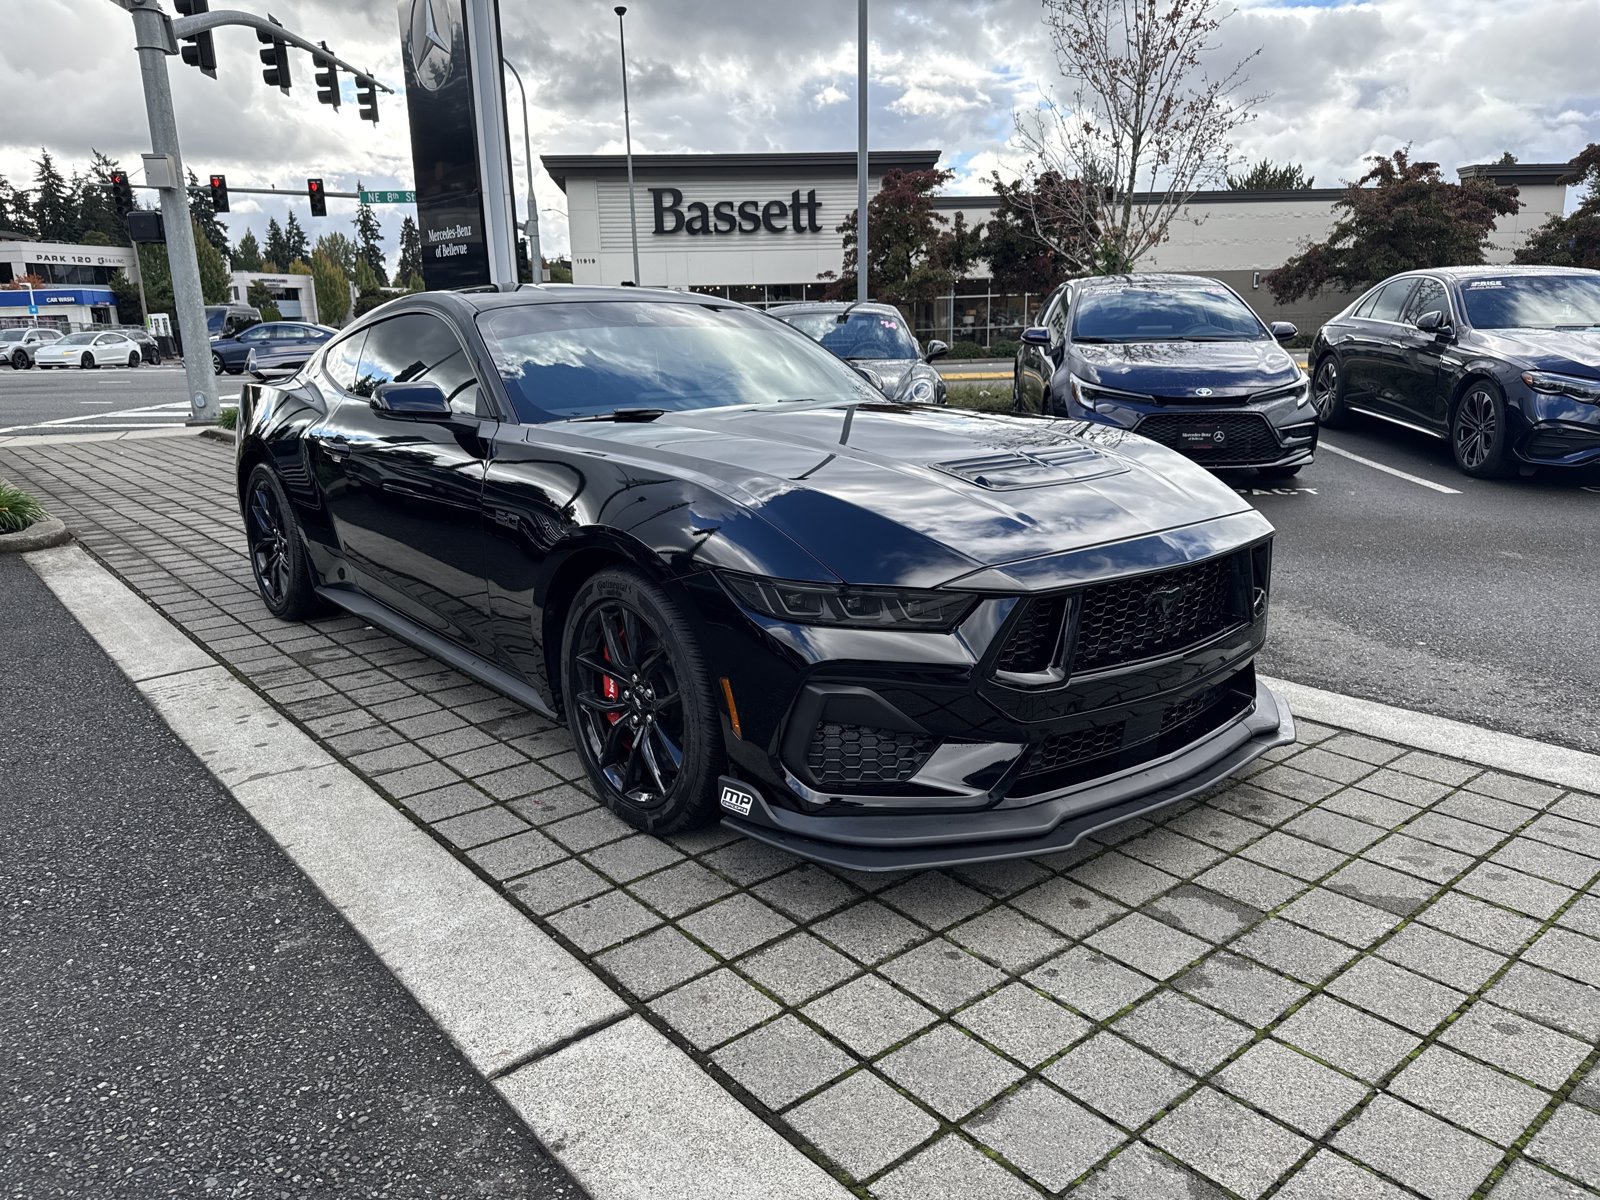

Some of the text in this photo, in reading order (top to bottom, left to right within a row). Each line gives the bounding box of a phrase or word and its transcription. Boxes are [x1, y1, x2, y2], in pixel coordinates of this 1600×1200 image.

[368, 192, 416, 202] NE 8th St
[648, 188, 823, 235] Bassett
[428, 225, 472, 242] Mercedes-Benz
[435, 243, 468, 258] of Bellevue
